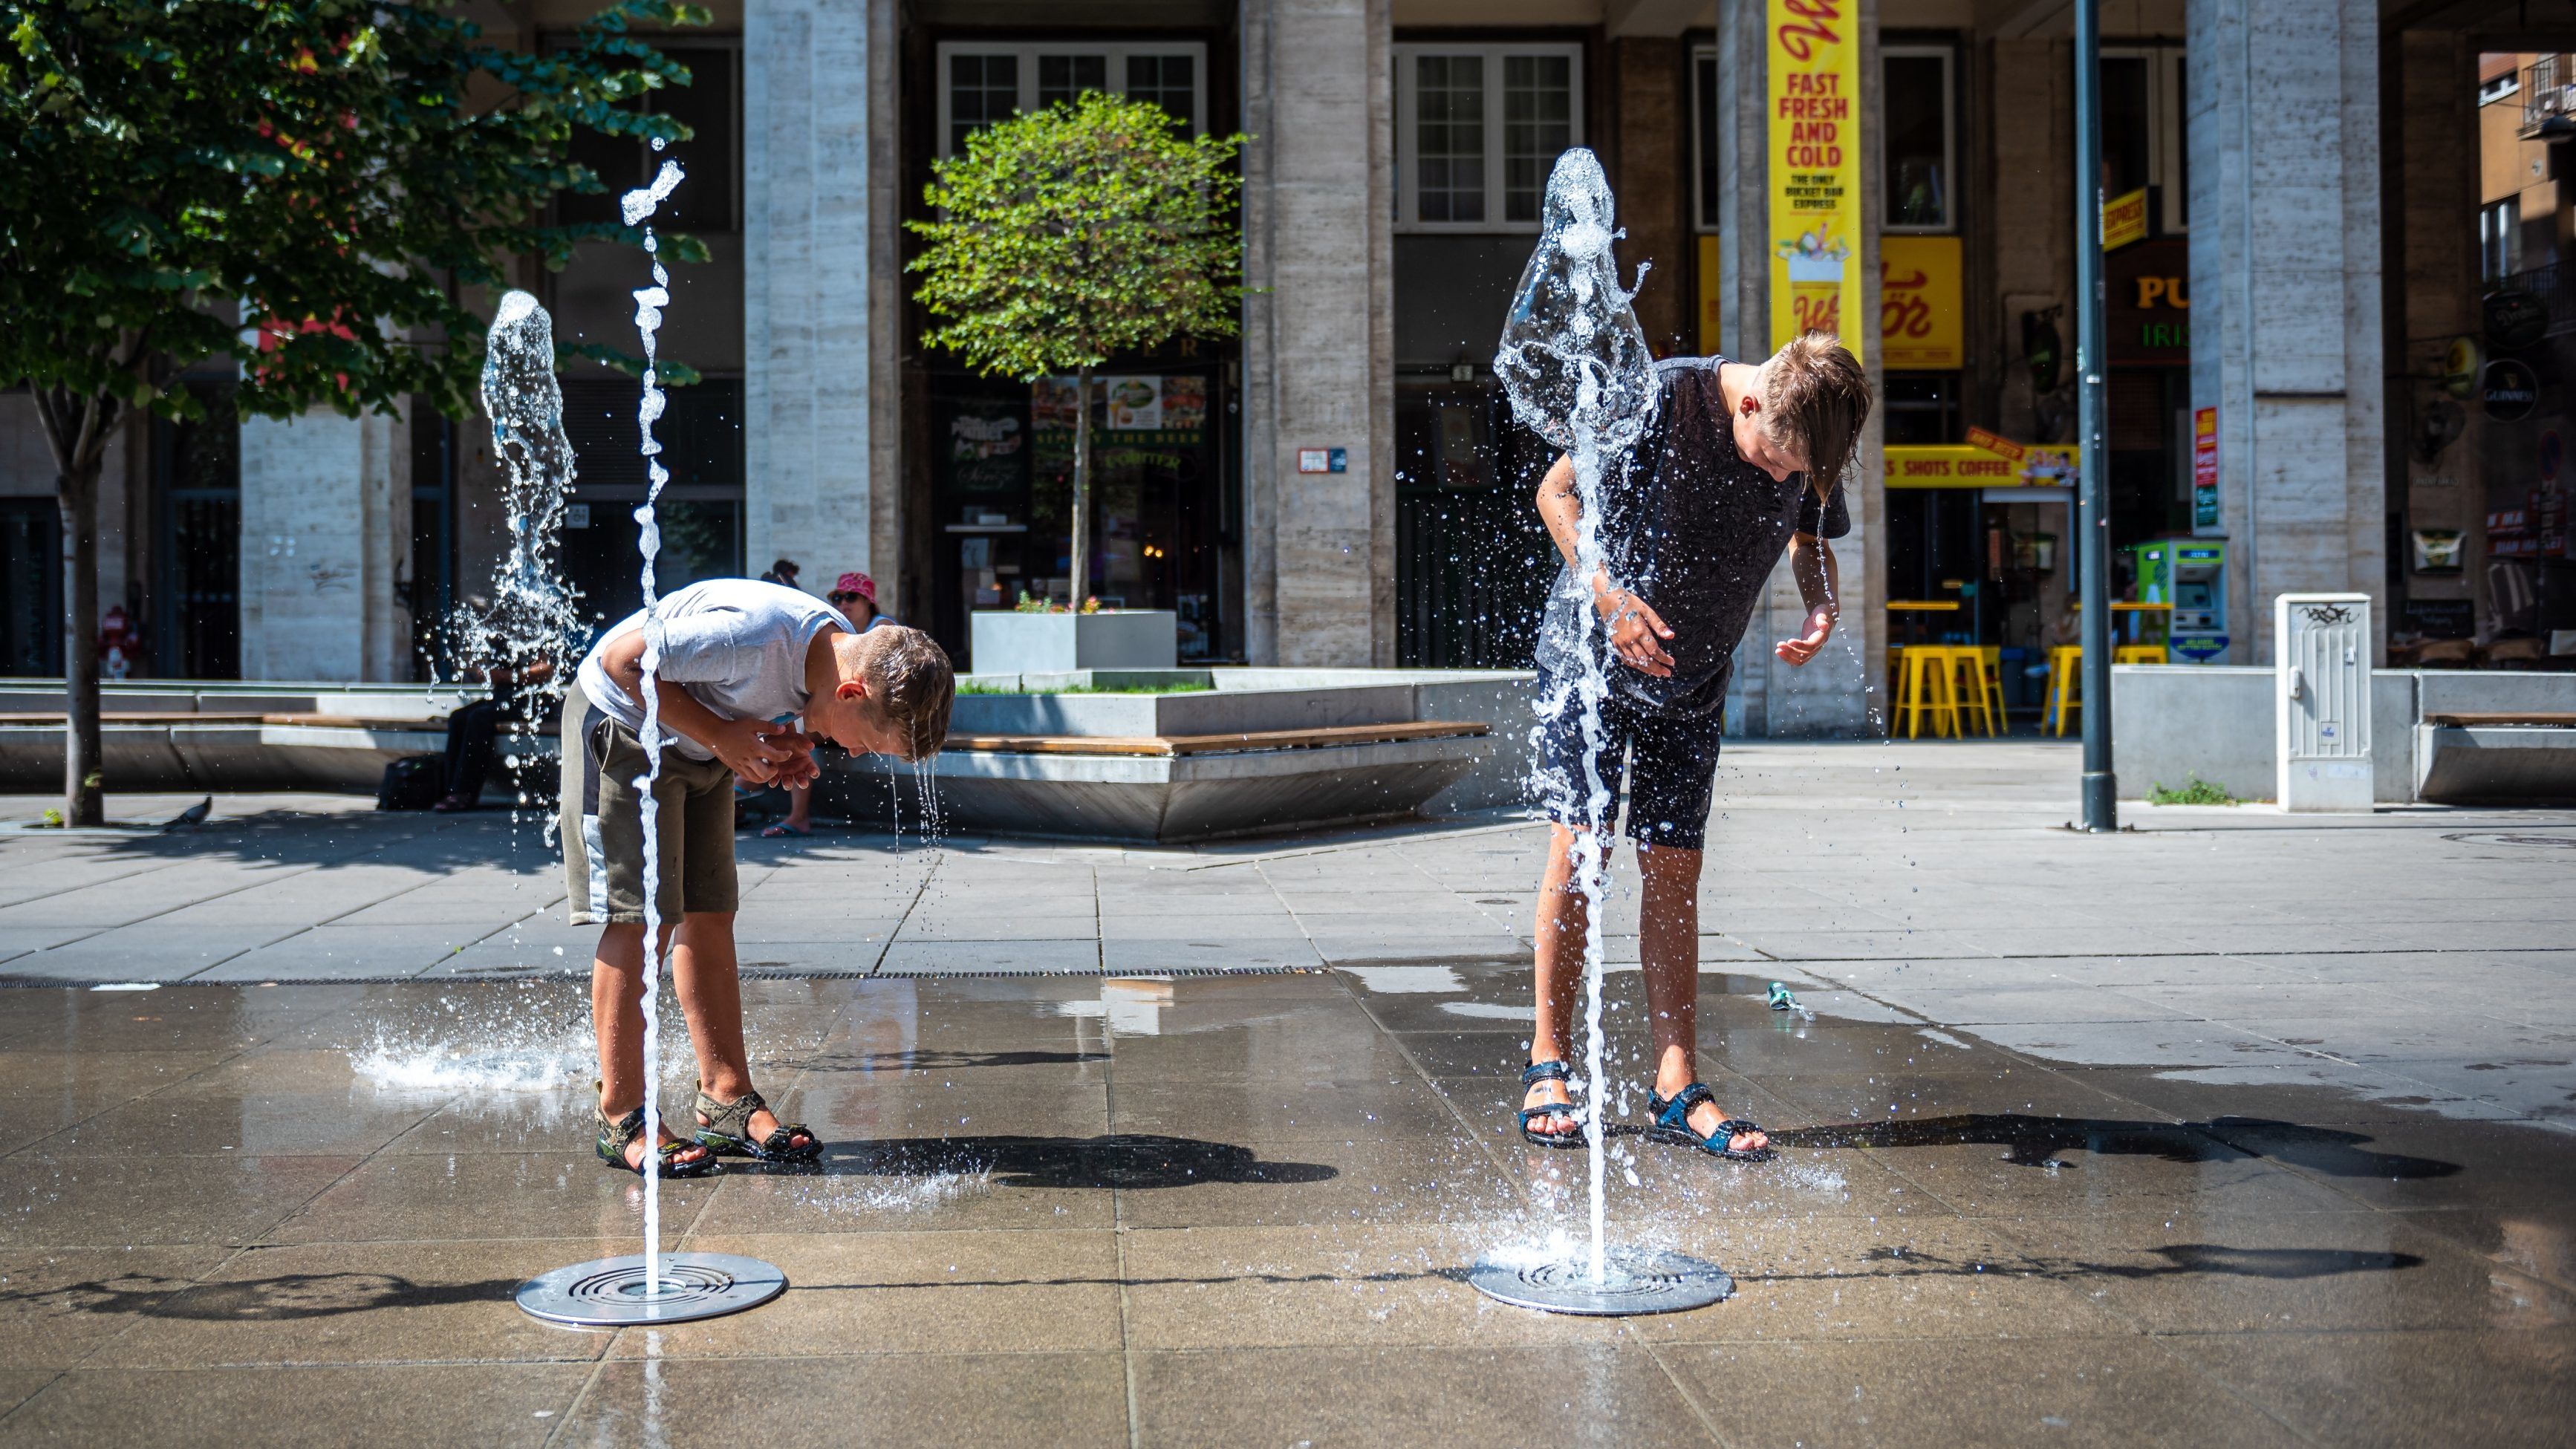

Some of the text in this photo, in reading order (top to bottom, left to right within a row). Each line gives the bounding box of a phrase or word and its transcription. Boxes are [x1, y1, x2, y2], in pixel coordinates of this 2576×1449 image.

[1787, 73, 1840, 95] FAST
[1779, 97, 1848, 120] FRESH
[1791, 122, 1838, 143] AND
[1786, 146, 1842, 168] COLD
[1791, 174, 1808, 184] THE
[1785, 187, 1821, 198] BUCKET
[1793, 199, 1836, 209] EXPRESS
[2484, 388, 2534, 403] GUINNESS
[1035, 433, 1102, 444] SIMY
[1904, 460, 1951, 477] SHOTS
[1957, 460, 2011, 477] COFFEE
